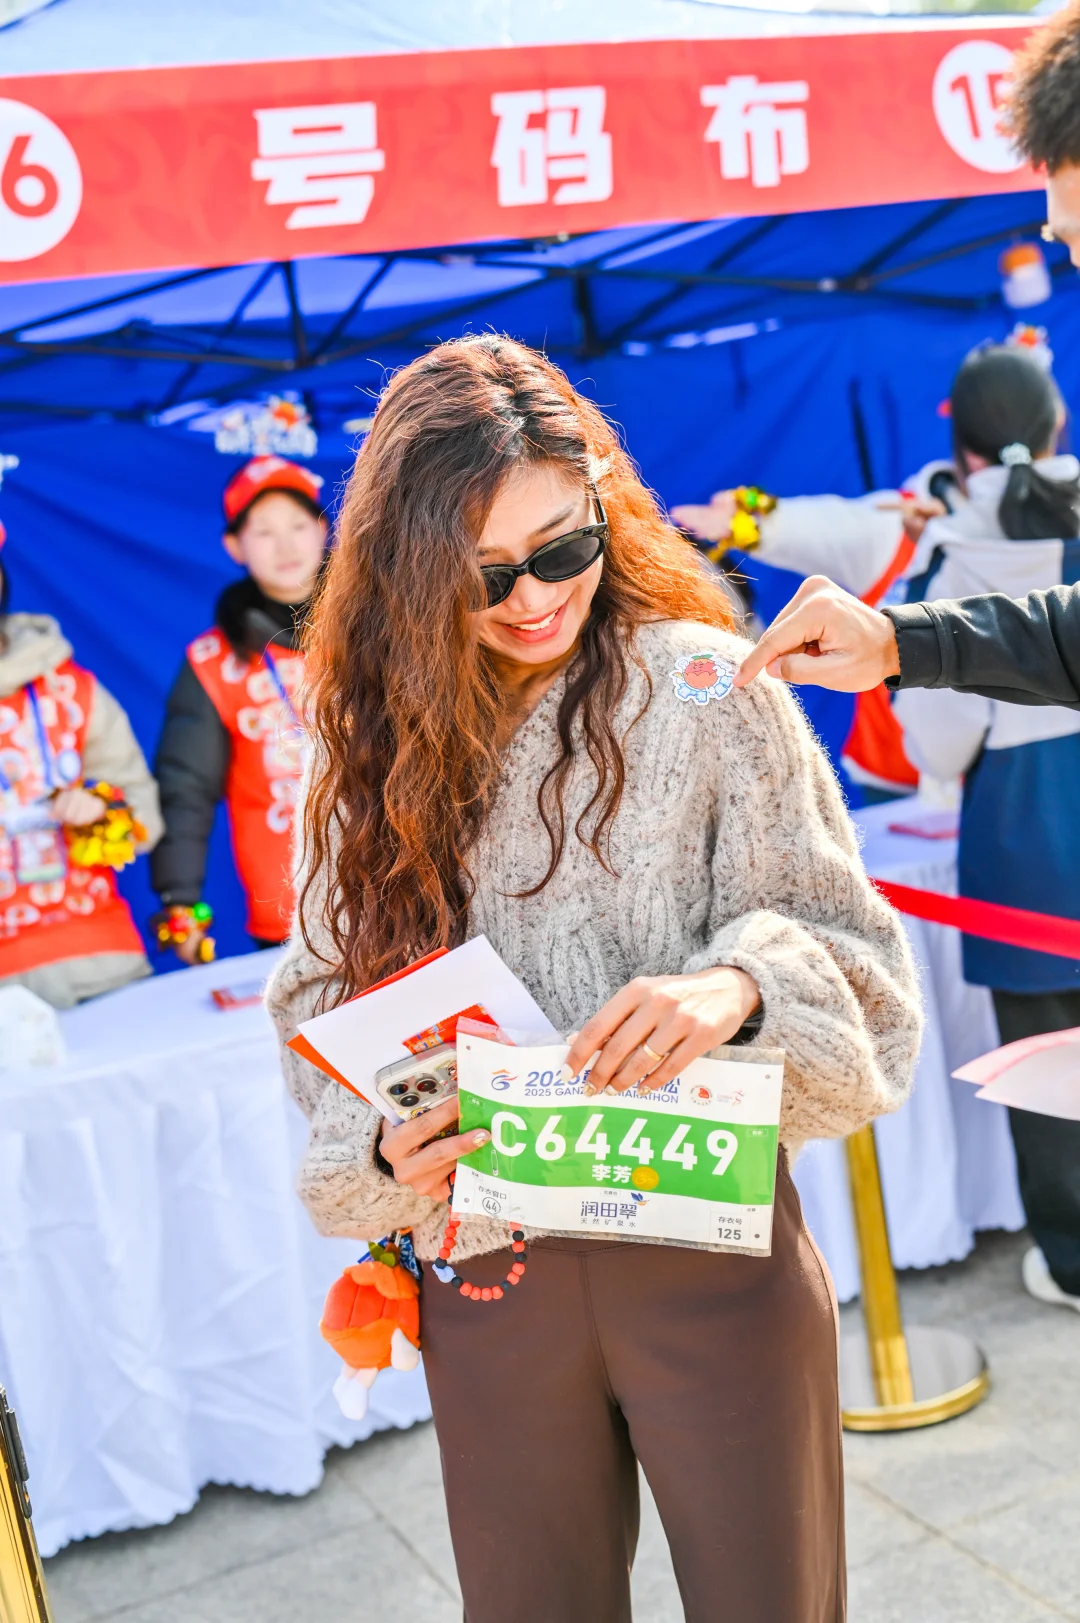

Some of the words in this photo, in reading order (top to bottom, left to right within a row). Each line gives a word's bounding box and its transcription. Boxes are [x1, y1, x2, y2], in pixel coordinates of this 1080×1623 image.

[251, 75, 810, 229] 号码布
[491, 1111, 739, 1176] C64449
[592, 1164, 632, 1183] 李芳
[485, 1200, 497, 1212] 44
[581, 1201, 637, 1219] 润田翠
[580, 1218, 637, 1228] 天然矿泉水
[718, 1216, 743, 1225] 存衣号
[717, 1228, 742, 1240] 125
